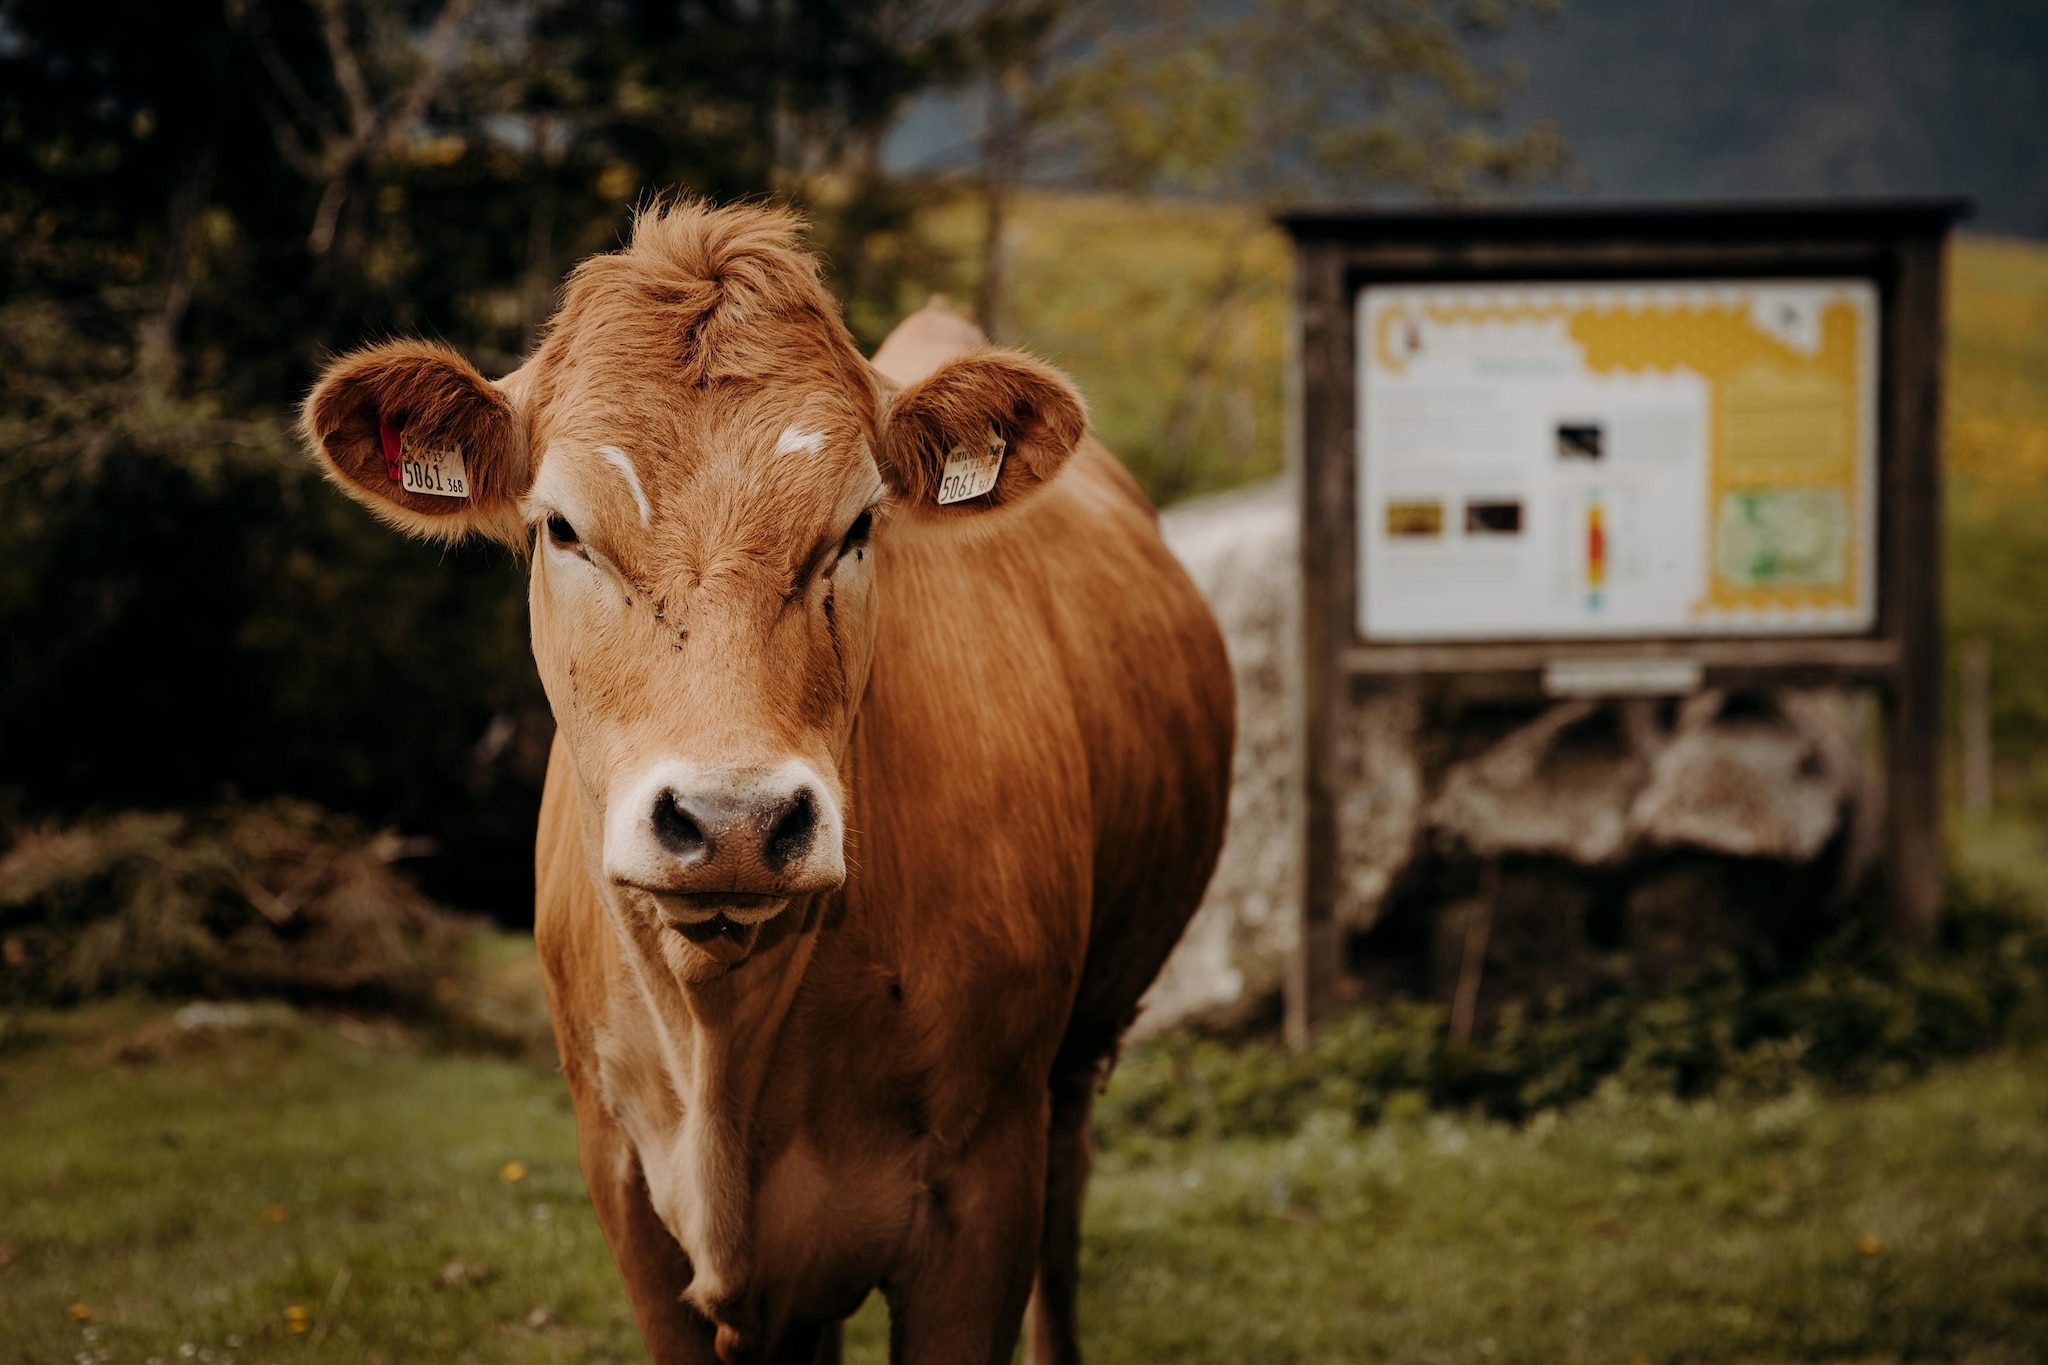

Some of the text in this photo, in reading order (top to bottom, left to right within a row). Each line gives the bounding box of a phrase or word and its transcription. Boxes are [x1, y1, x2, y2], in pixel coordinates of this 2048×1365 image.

[404, 460, 463, 493] 5061 368
[941, 472, 976, 501] 5061
